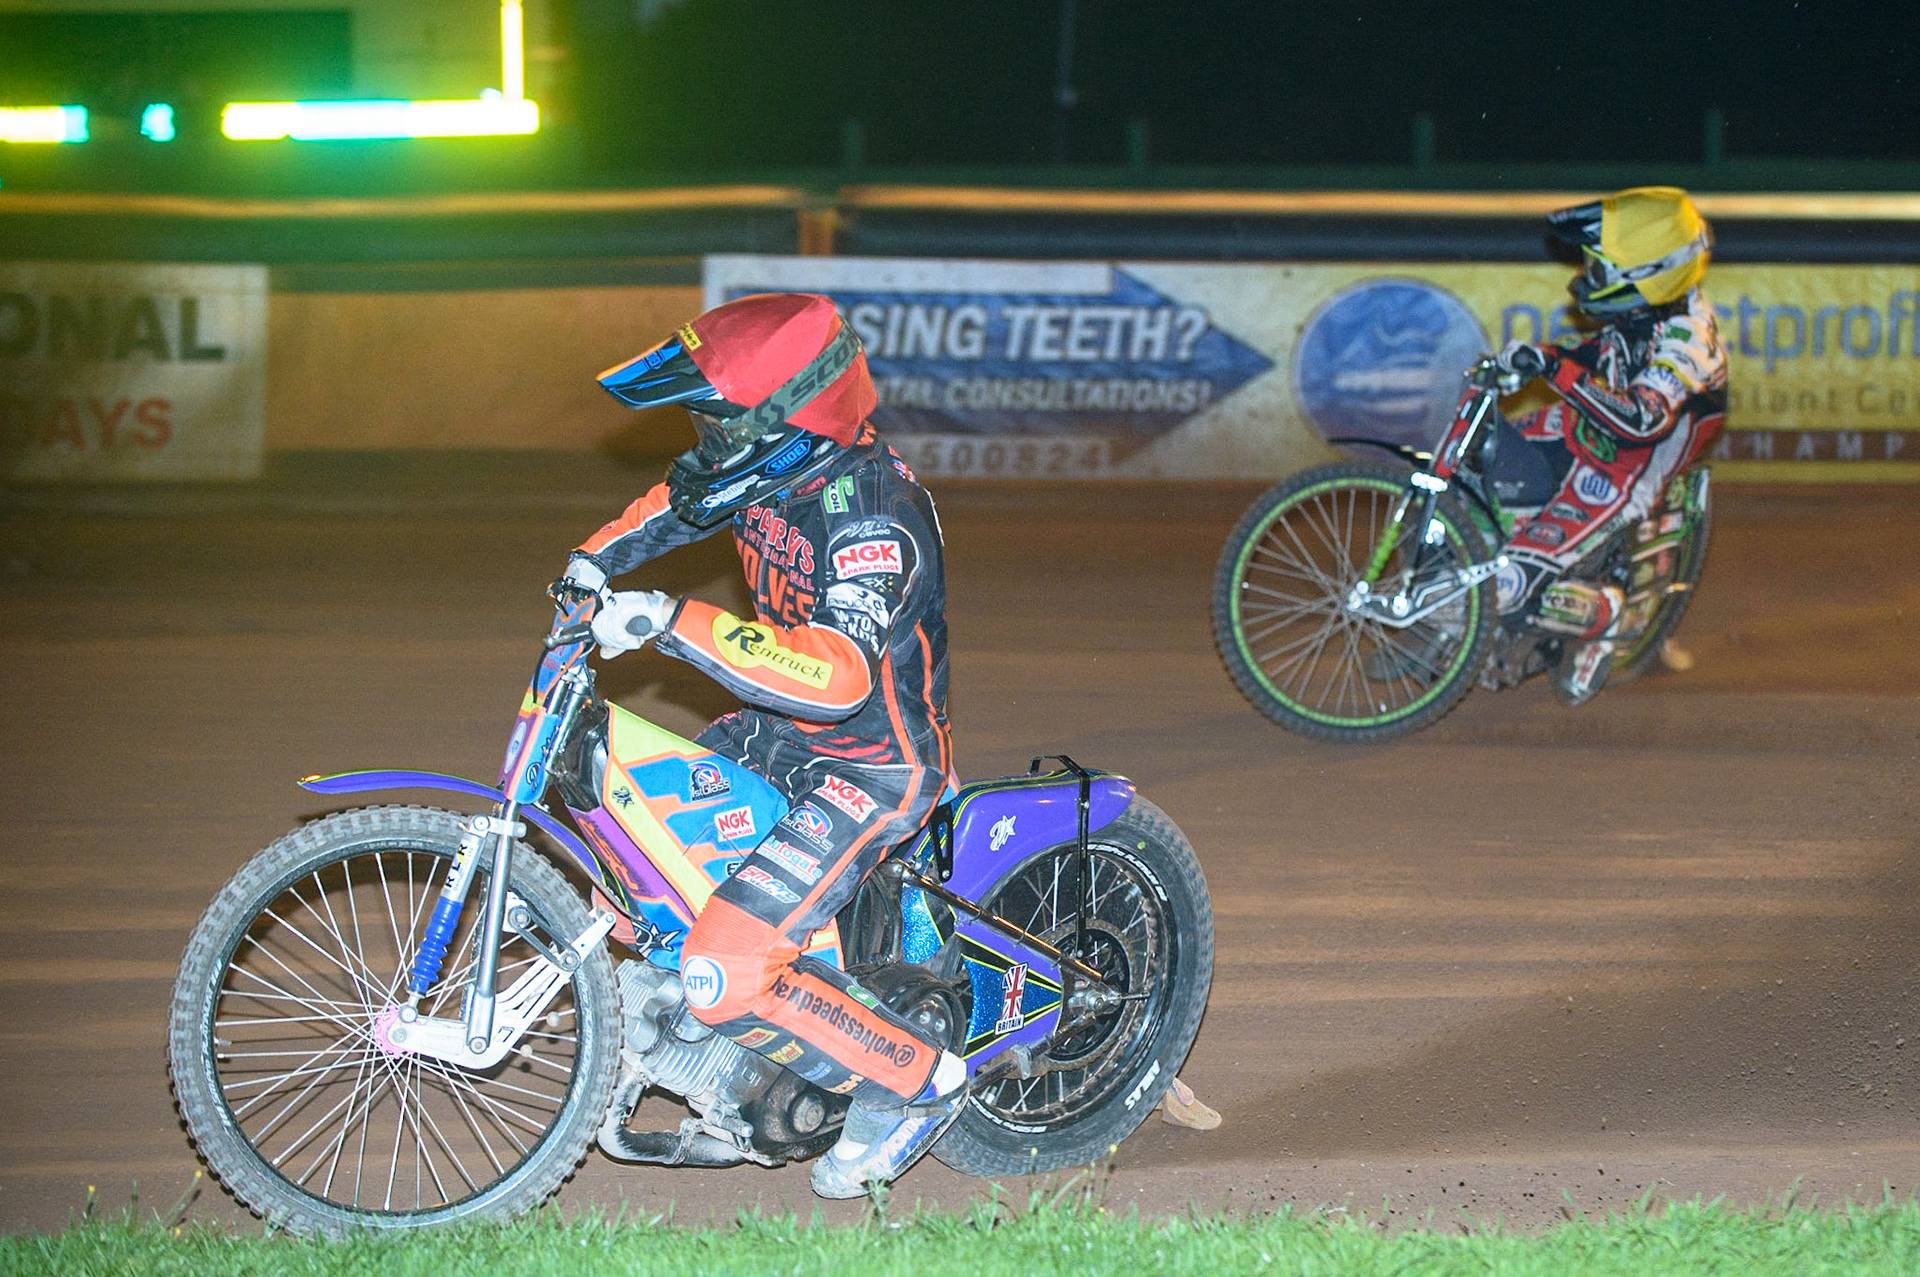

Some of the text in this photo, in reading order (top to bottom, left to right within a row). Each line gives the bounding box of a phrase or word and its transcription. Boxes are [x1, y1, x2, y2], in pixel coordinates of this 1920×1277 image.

[848, 304, 1210, 362] SING TEETH?
[946, 379, 1212, 412] CONSULTATIONS!
[771, 441, 807, 472] SHOEI
[746, 504, 815, 575] PARYS
[838, 543, 898, 570] NGK
[724, 625, 827, 681] Rentruck
[823, 776, 873, 814] NGK
[718, 810, 750, 832] NGK
[761, 836, 823, 878] Autogate
[685, 974, 713, 990] ATPI
[769, 974, 916, 1068] @wolvesspeedway
[997, 1018, 1022, 1032] BRITAIN
